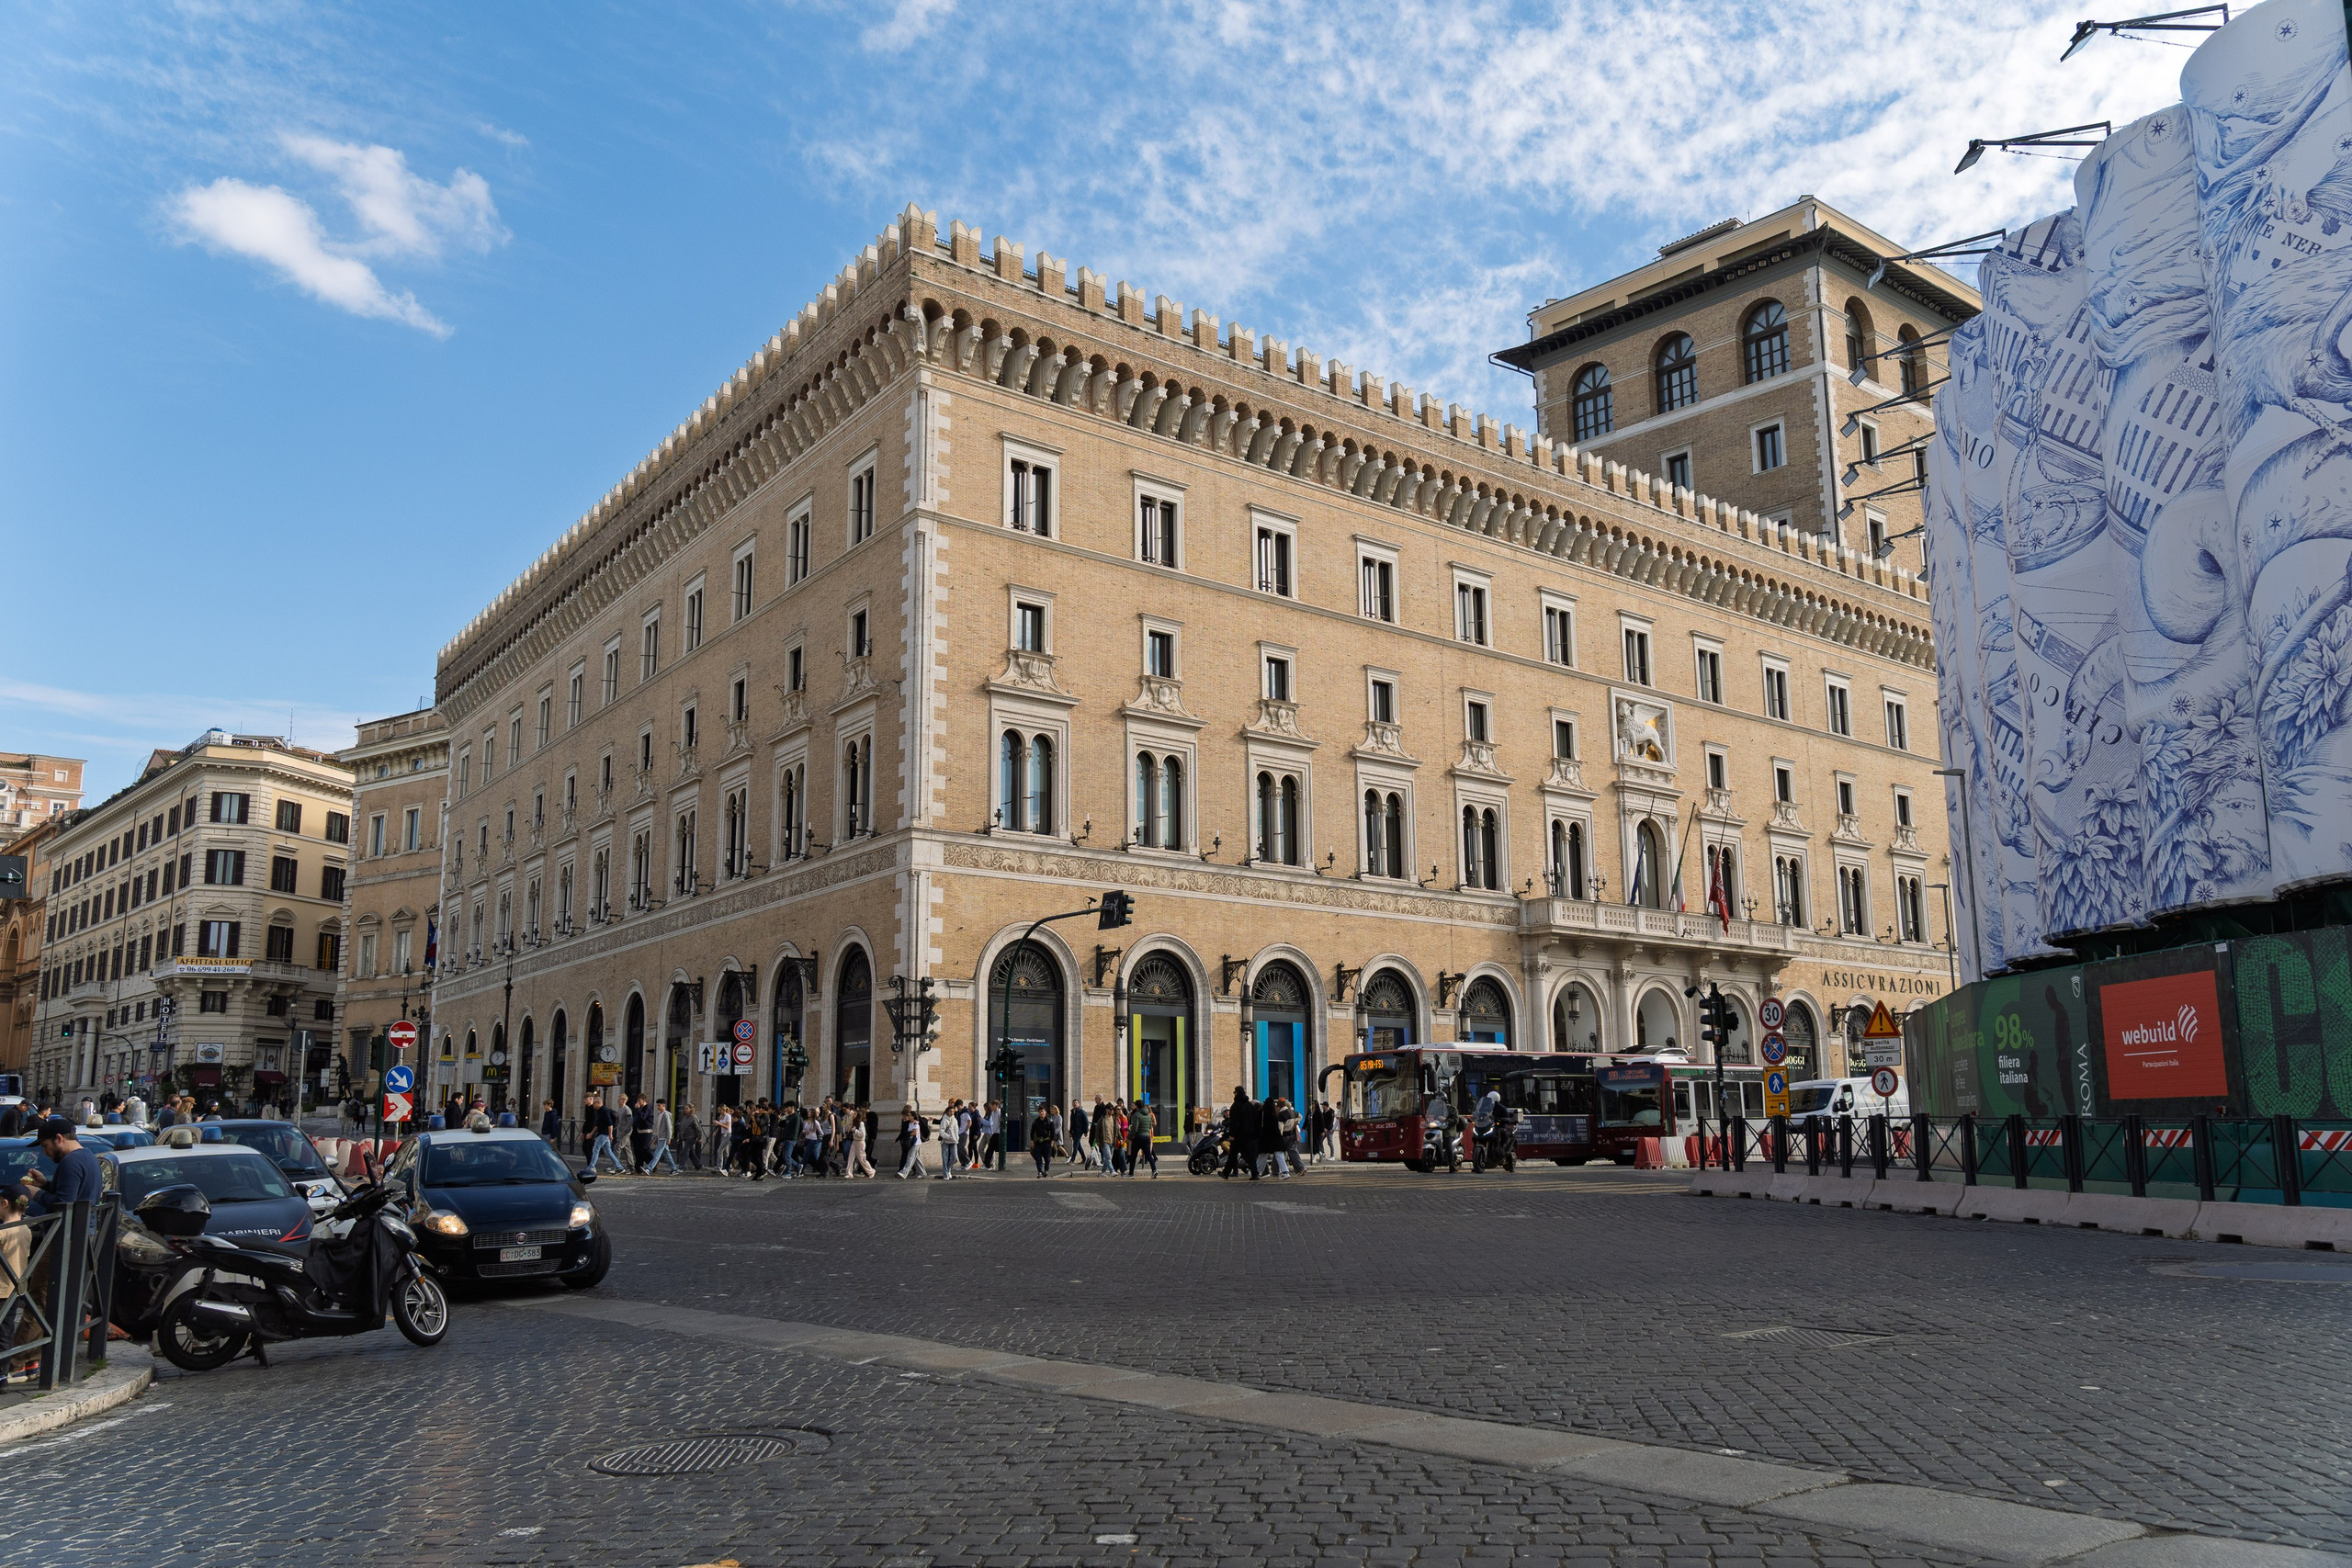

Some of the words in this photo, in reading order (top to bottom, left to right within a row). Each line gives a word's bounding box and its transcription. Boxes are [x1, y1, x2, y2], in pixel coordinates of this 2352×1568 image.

[2280, 232, 2332, 255] NER
[1822, 970, 1941, 996] ASSICVRAZIONI
[160, 998, 170, 1041] HOTEL
[1764, 1007, 1779, 1021] 30
[1995, 1013, 2034, 1051] 98%
[2121, 1020, 2177, 1045] webuild
[1360, 1061, 1367, 1070] 85
[1997, 1055, 2020, 1069] filiera
[1608, 1070, 1619, 1081] 100
[1999, 1071, 2029, 1084] italiana
[2076, 1043, 2092, 1117] ROMA
